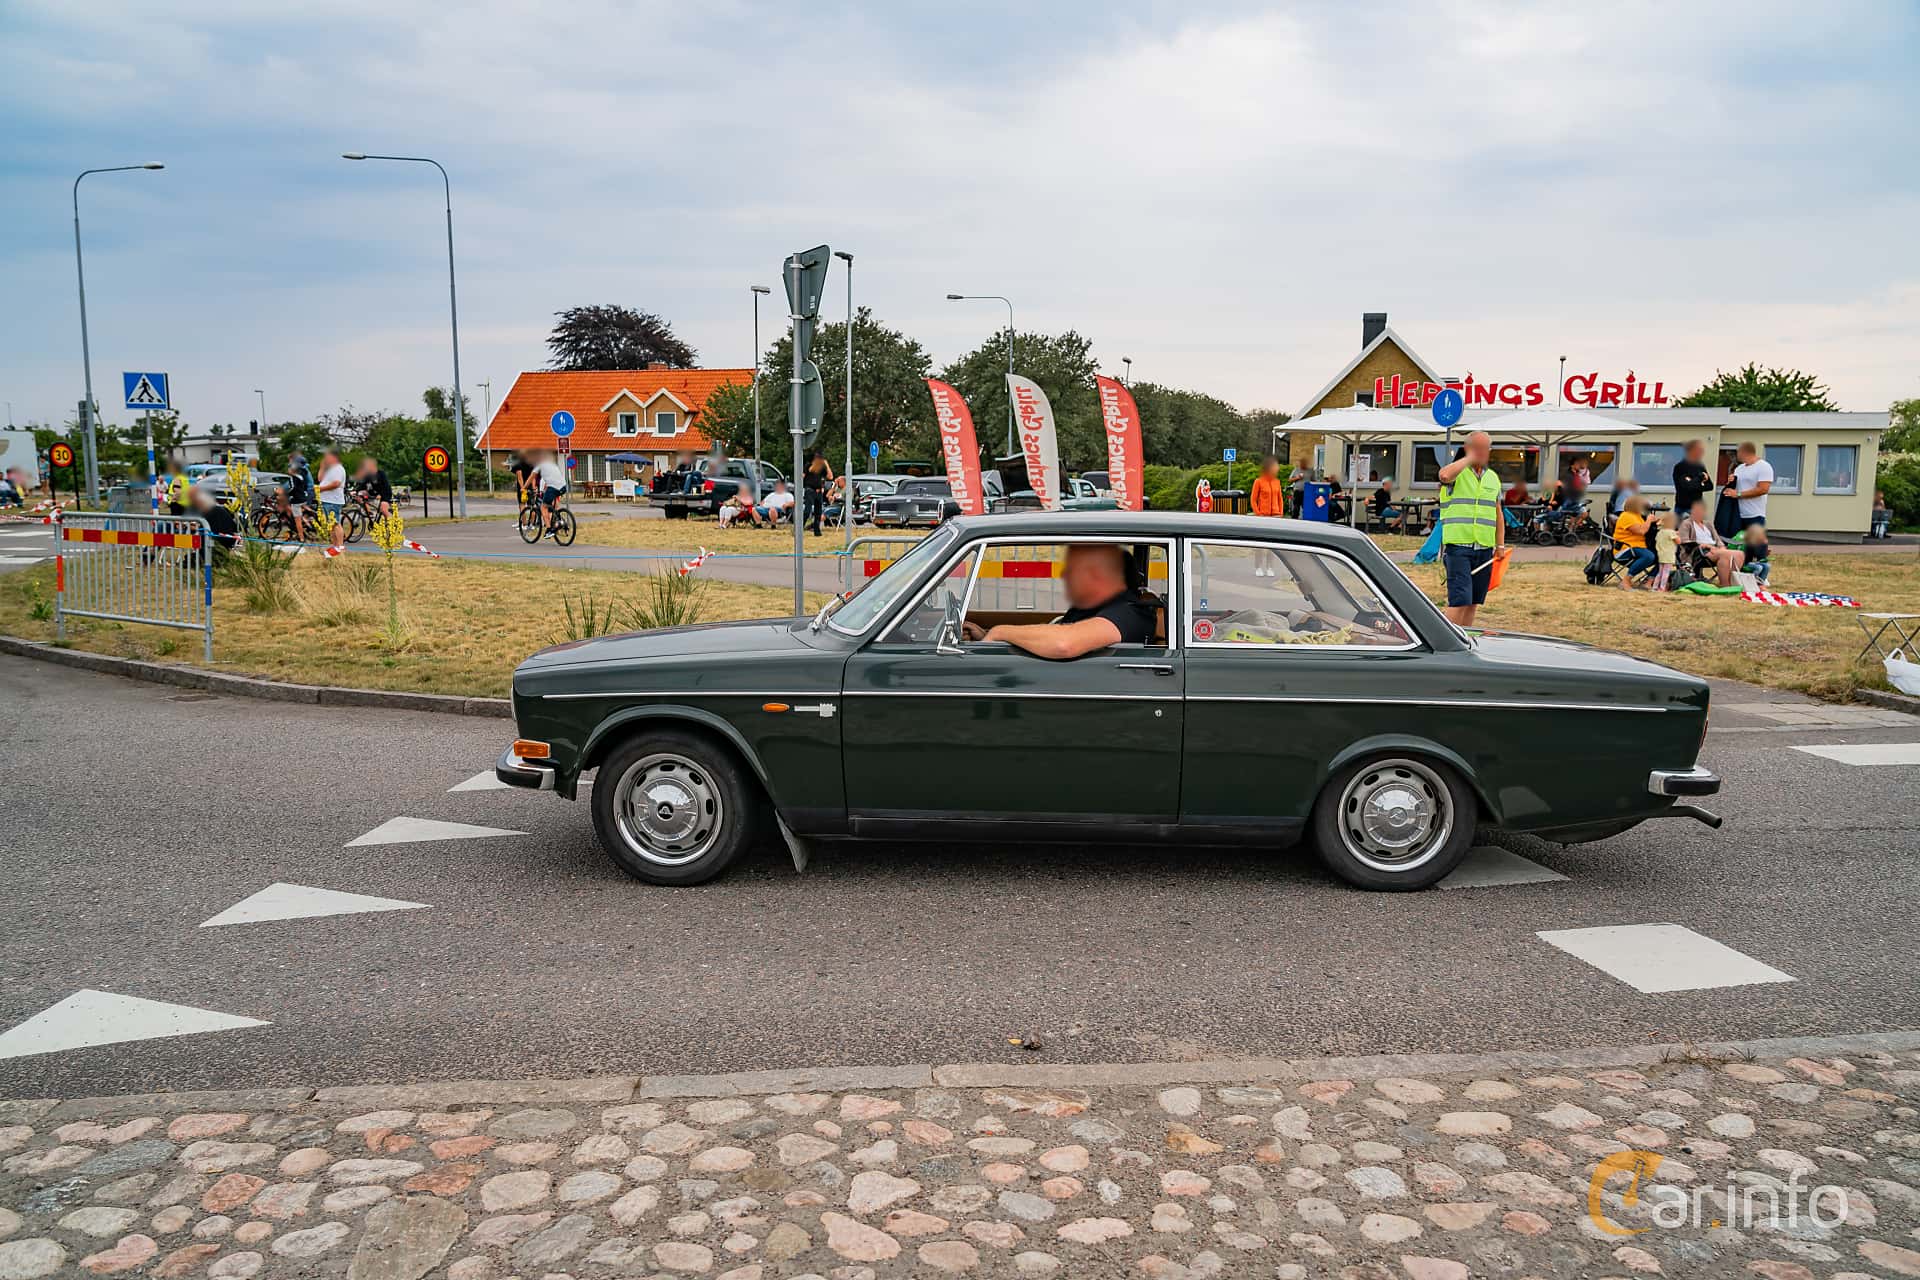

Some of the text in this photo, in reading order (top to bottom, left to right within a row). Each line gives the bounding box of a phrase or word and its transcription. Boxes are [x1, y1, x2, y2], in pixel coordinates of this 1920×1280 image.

[1563, 369, 1668, 408] GRILL
[55, 449, 69, 461] 30
[429, 454, 445, 466] 30
